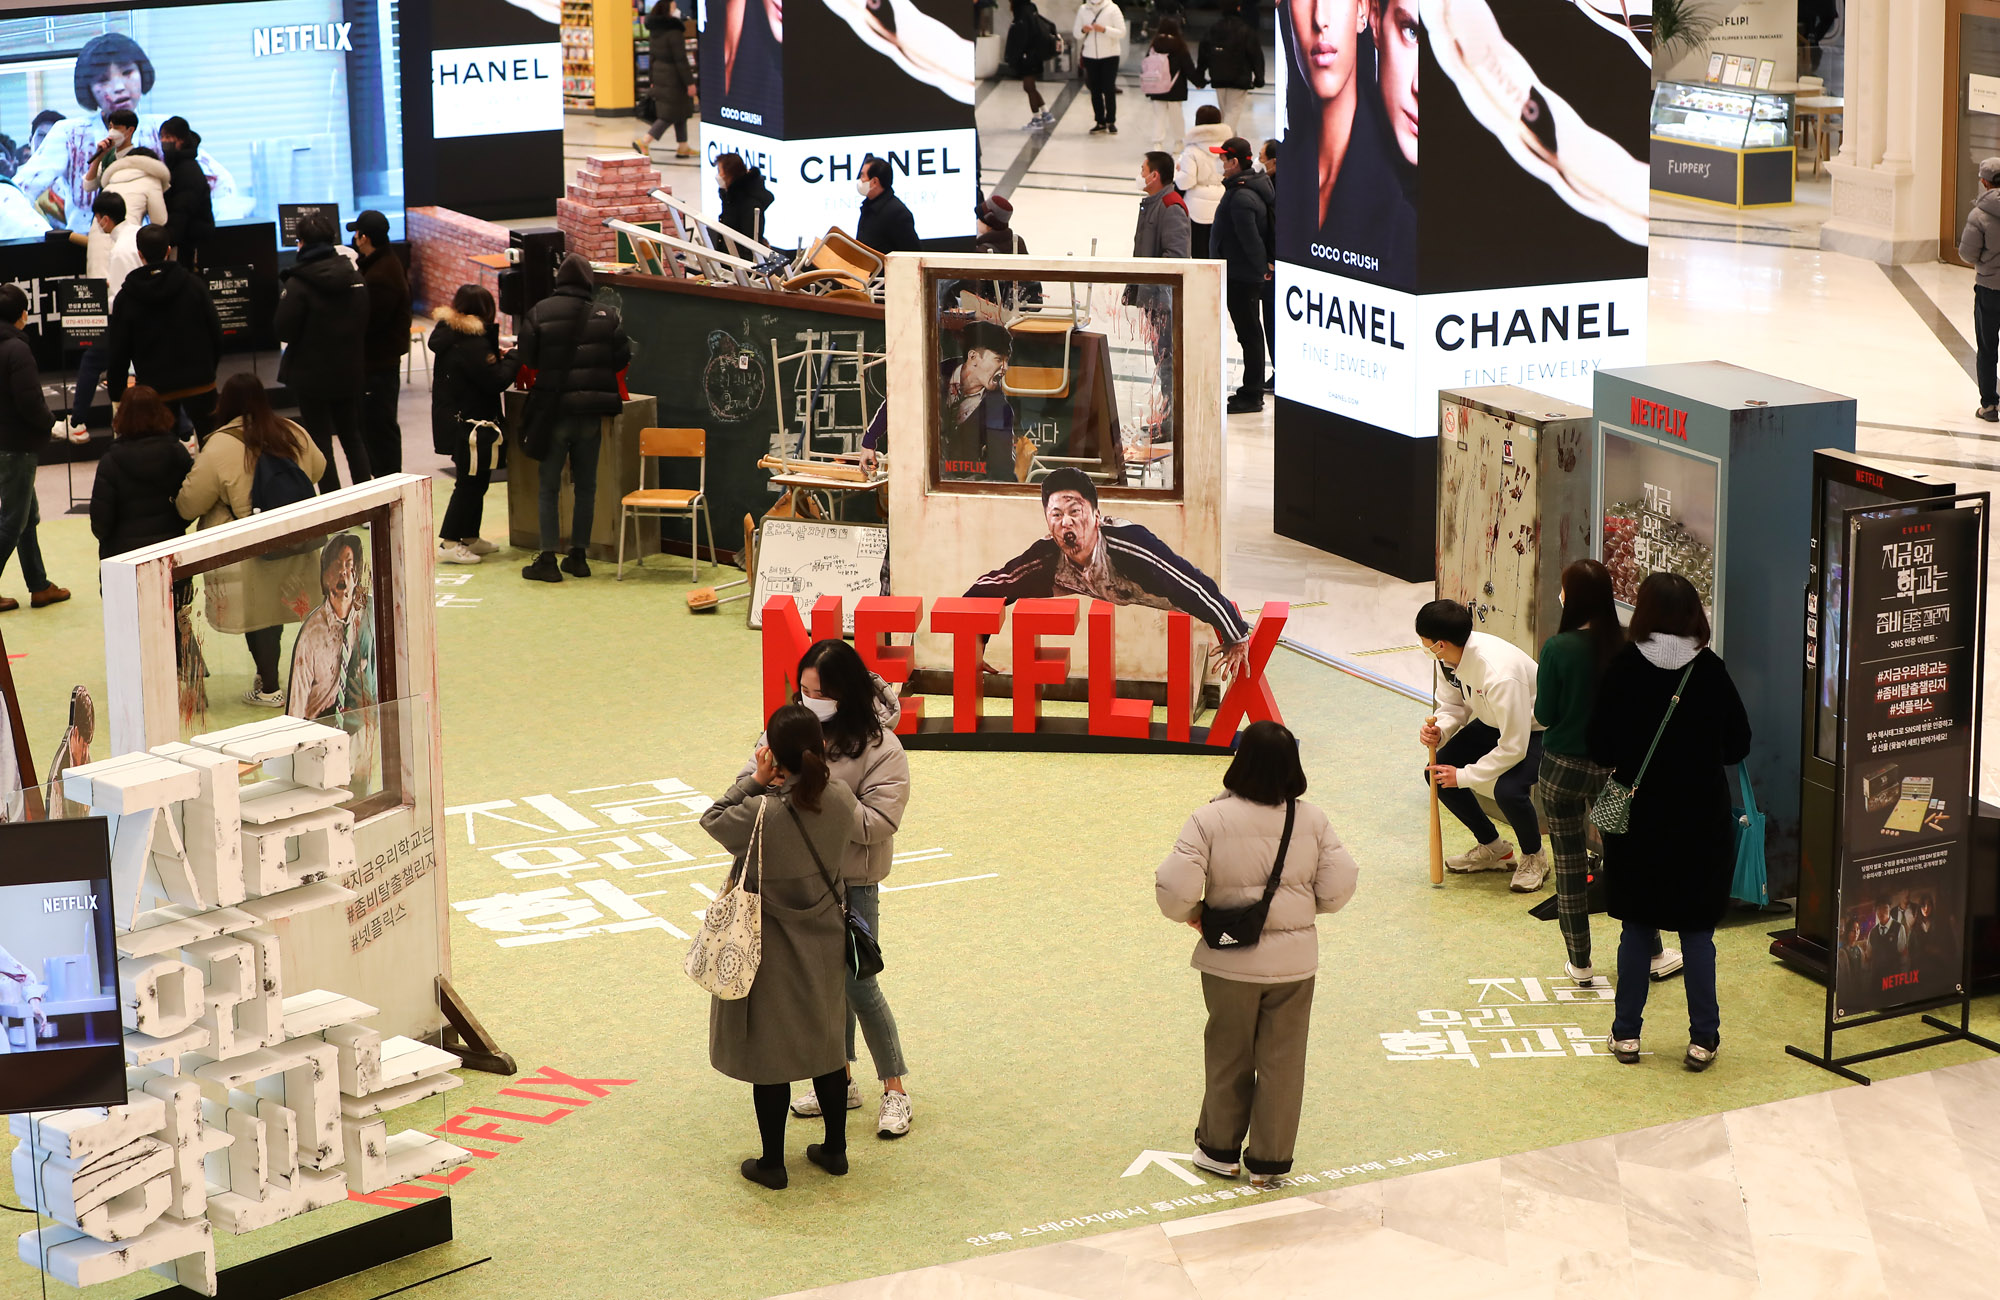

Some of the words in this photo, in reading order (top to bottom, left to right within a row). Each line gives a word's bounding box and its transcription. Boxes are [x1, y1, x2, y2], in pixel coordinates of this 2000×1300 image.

[253, 22, 353, 57] NETFLIX
[431, 58, 549, 86] HANEL
[721, 106, 740, 121] COCO
[740, 110, 762, 127] CRUSH
[1310, 242, 1341, 262] COCO
[1342, 250, 1379, 272] CRUSH
[1286, 285, 1405, 351] CHANEL
[1435, 302, 1630, 351] CHANEL
[1302, 342, 1330, 367] FINE
[1333, 352, 1388, 382] JEWELRY
[1464, 366, 1509, 387] FINE
[1517, 358, 1602, 385] JEWELRY
[1630, 395, 1689, 441] NETFLIX
[945, 460, 987, 474] NETFLIX
[1856, 469, 1884, 490] NETFLIX
[1902, 523, 1932, 535] EVENT
[1882, 541, 1913, 571] 지금
[1913, 543, 1934, 565] 우리
[1896, 564, 1949, 605] 학교는
[1876, 610, 1902, 635] 좀비
[761, 595, 1291, 747] NETFLIX
[1877, 661, 1948, 683] #지금우리학교는
[1876, 677, 1946, 701] #좀비탈출챌린지
[1889, 698, 1933, 715] #넷플릭스
[342, 826, 434, 890] #지금우리학교는
[346, 852, 437, 925] #좀비탈출챌린지
[43, 894, 98, 914] NETFLIX
[351, 903, 407, 952] #넷플릭스
[1882, 969, 1920, 991] NETFLIX
[966, 1231, 1014, 1247] 안쪽
[1020, 1205, 1149, 1238] 스테이지에서
[1387, 1149, 1458, 1168] 보세요.
